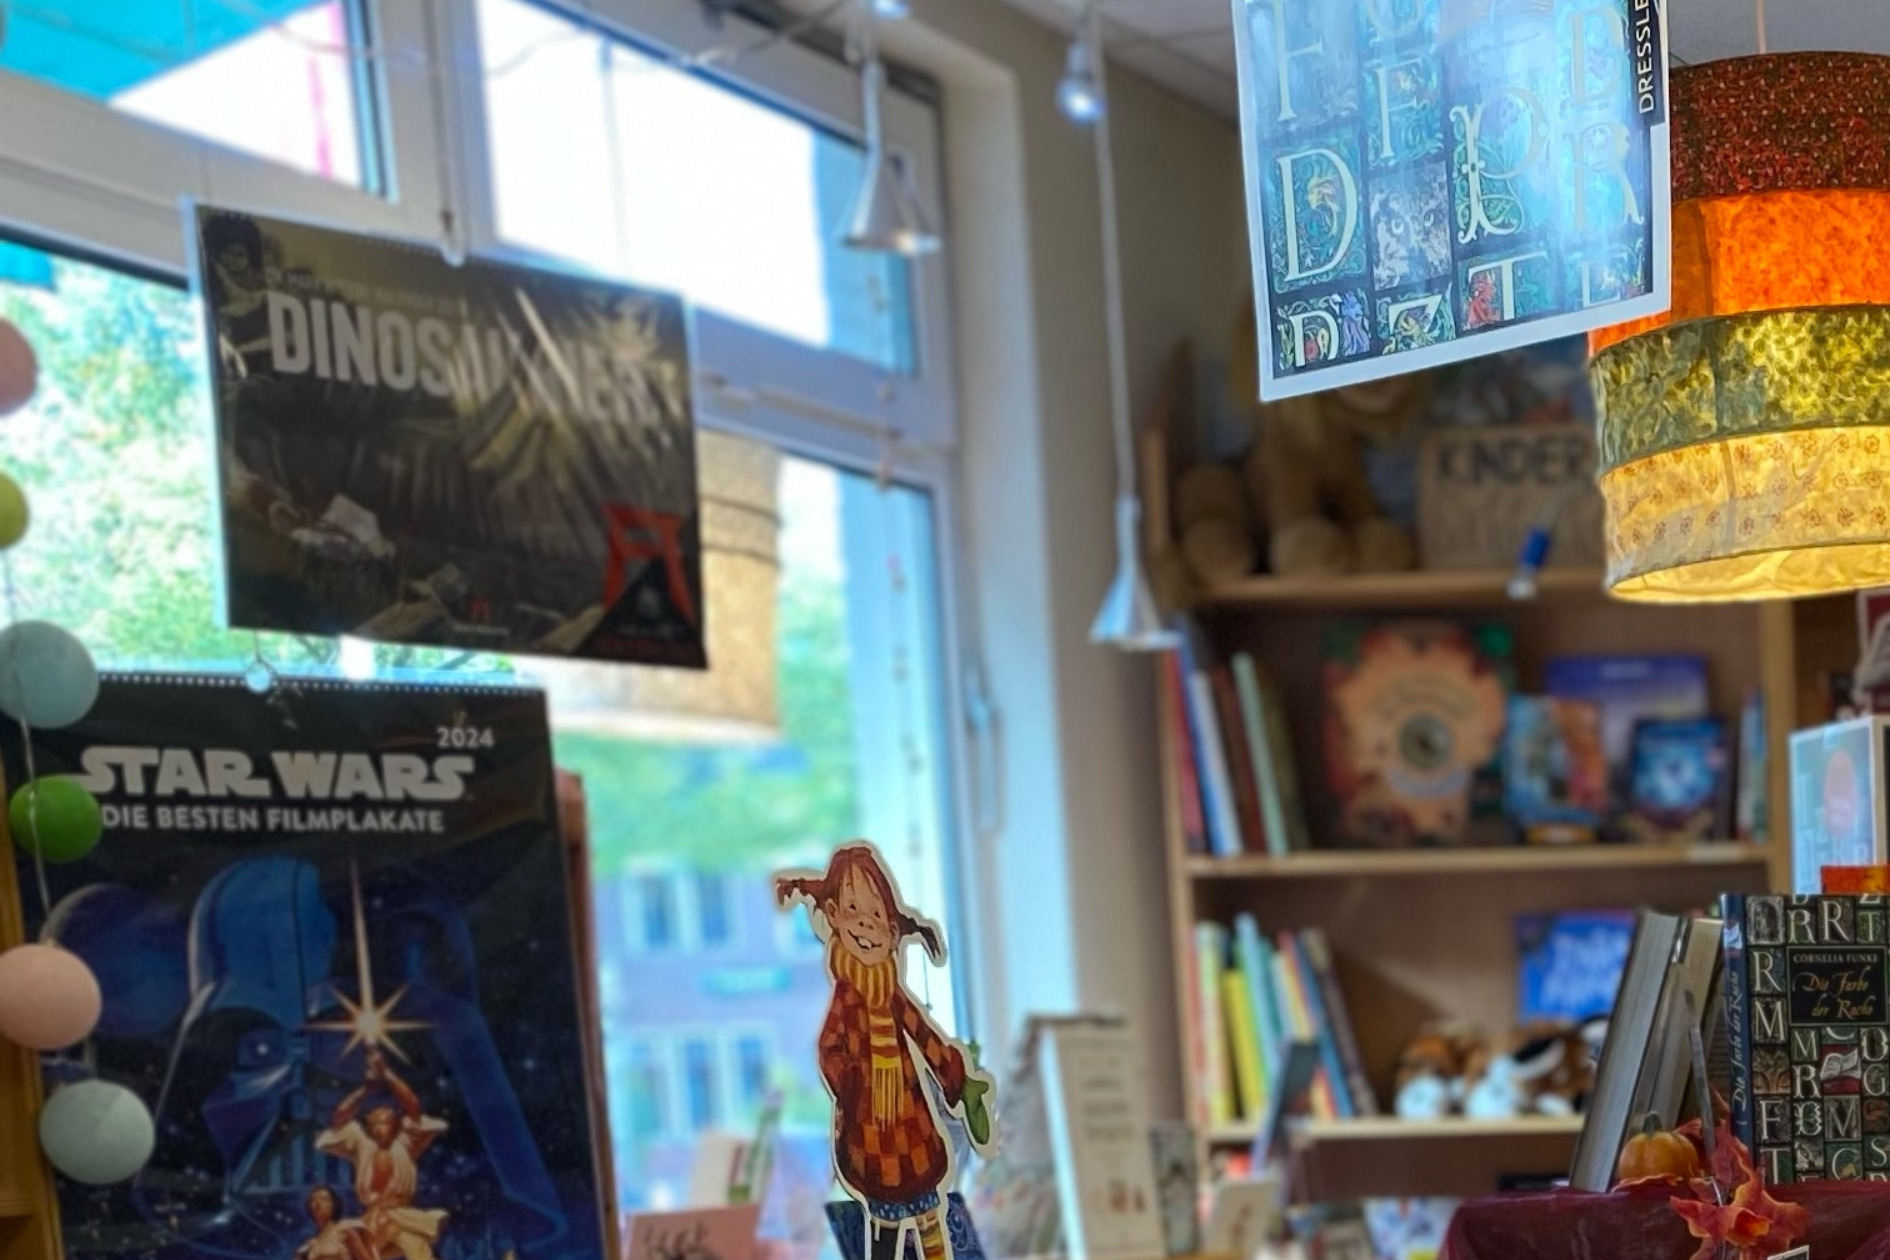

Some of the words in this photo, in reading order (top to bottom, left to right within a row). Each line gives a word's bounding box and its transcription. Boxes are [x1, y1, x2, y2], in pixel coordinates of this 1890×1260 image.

[437, 727, 495, 749] 2024
[80, 746, 272, 797] STAR
[270, 751, 475, 802] WARS
[102, 806, 148, 829] DIE
[158, 807, 259, 831] BESTEN
[266, 808, 445, 833] FILMPLAKATE
[1792, 954, 1845, 964] CORNELIA
[1847, 953, 1878, 964] FUNKE
